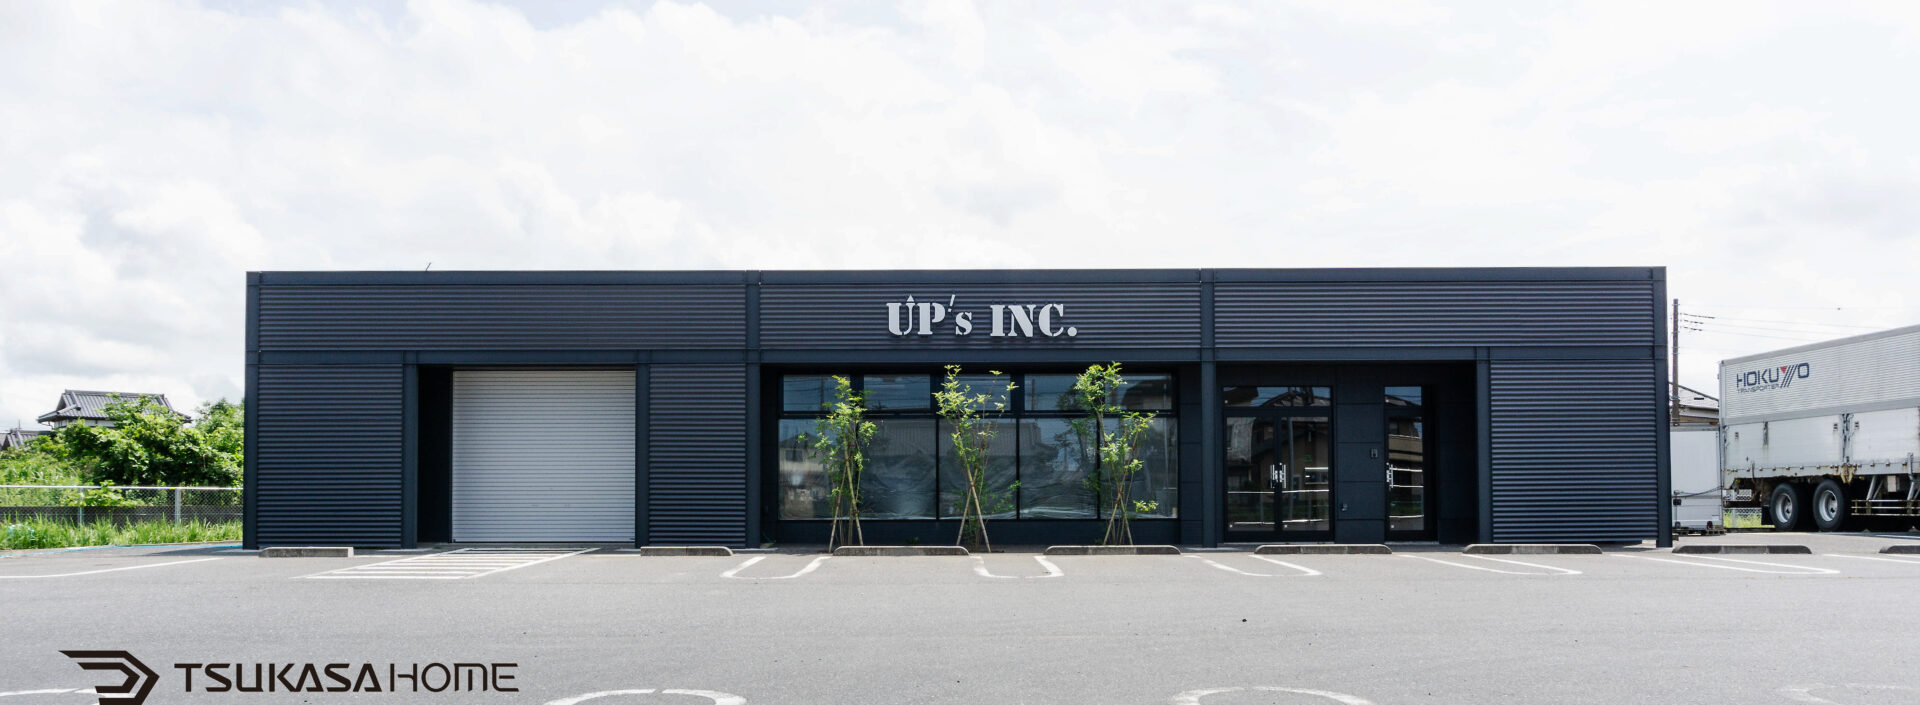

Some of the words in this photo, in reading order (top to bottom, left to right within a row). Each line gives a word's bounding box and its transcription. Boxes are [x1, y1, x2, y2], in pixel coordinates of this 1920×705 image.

[886, 294, 973, 336] UP's
[990, 303, 1078, 338] INC.
[1736, 362, 1810, 388] HOKUYO
